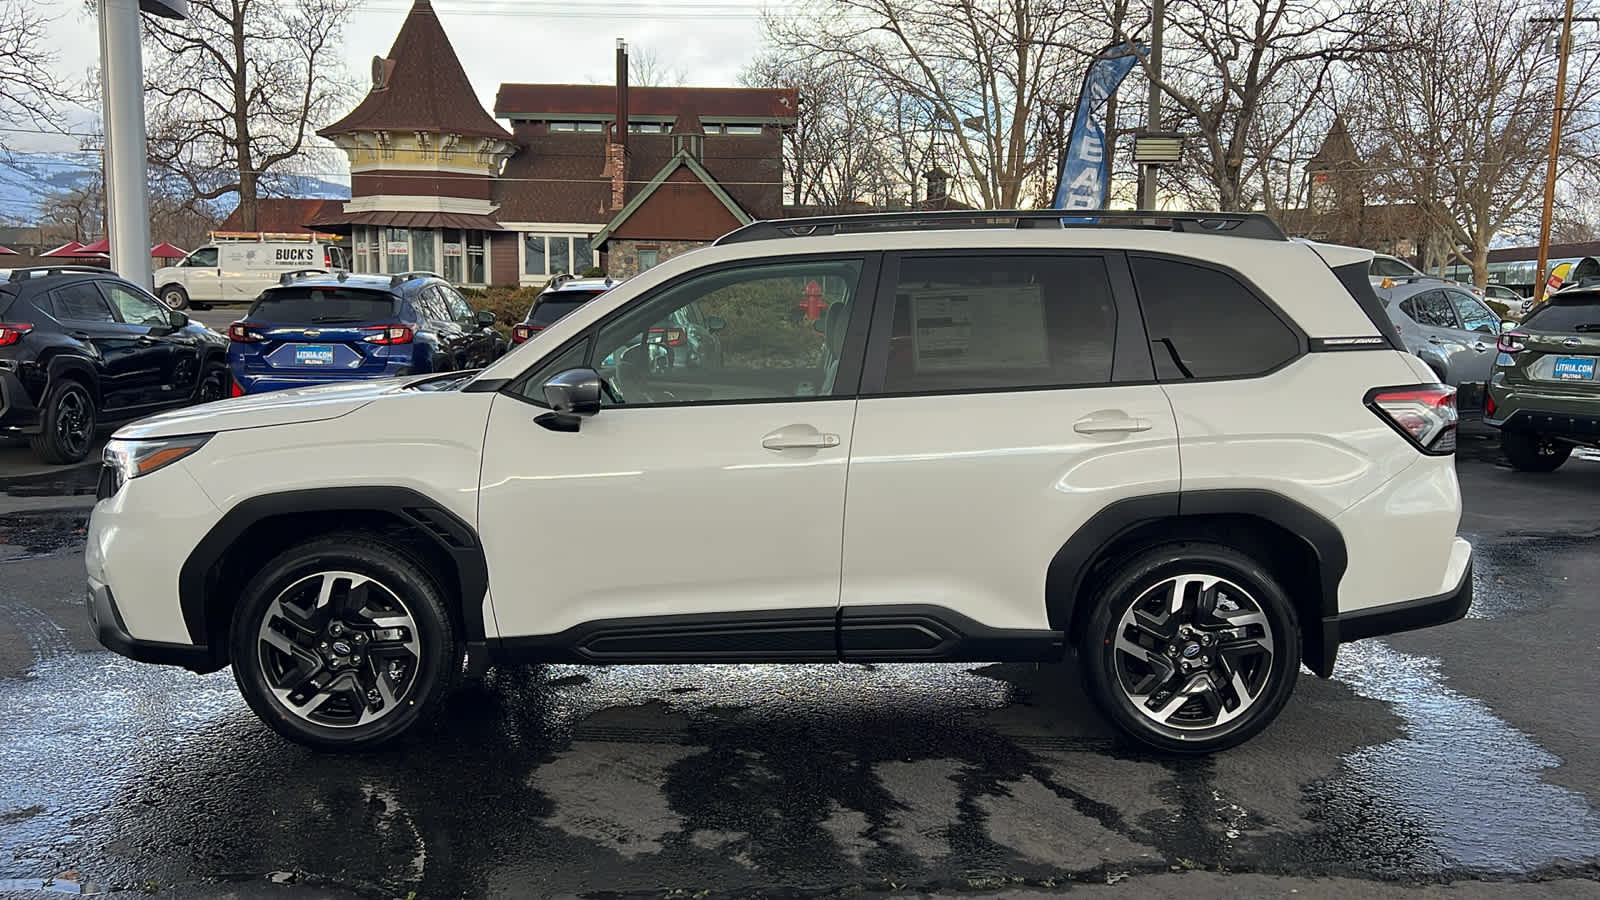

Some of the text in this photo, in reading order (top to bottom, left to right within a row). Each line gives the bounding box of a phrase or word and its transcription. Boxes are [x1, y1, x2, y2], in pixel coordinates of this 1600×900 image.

[275, 248, 314, 260] BUCK'S
[296, 351, 333, 359] LITHIA.COM
[1555, 363, 1593, 373] LITHIA.COM
